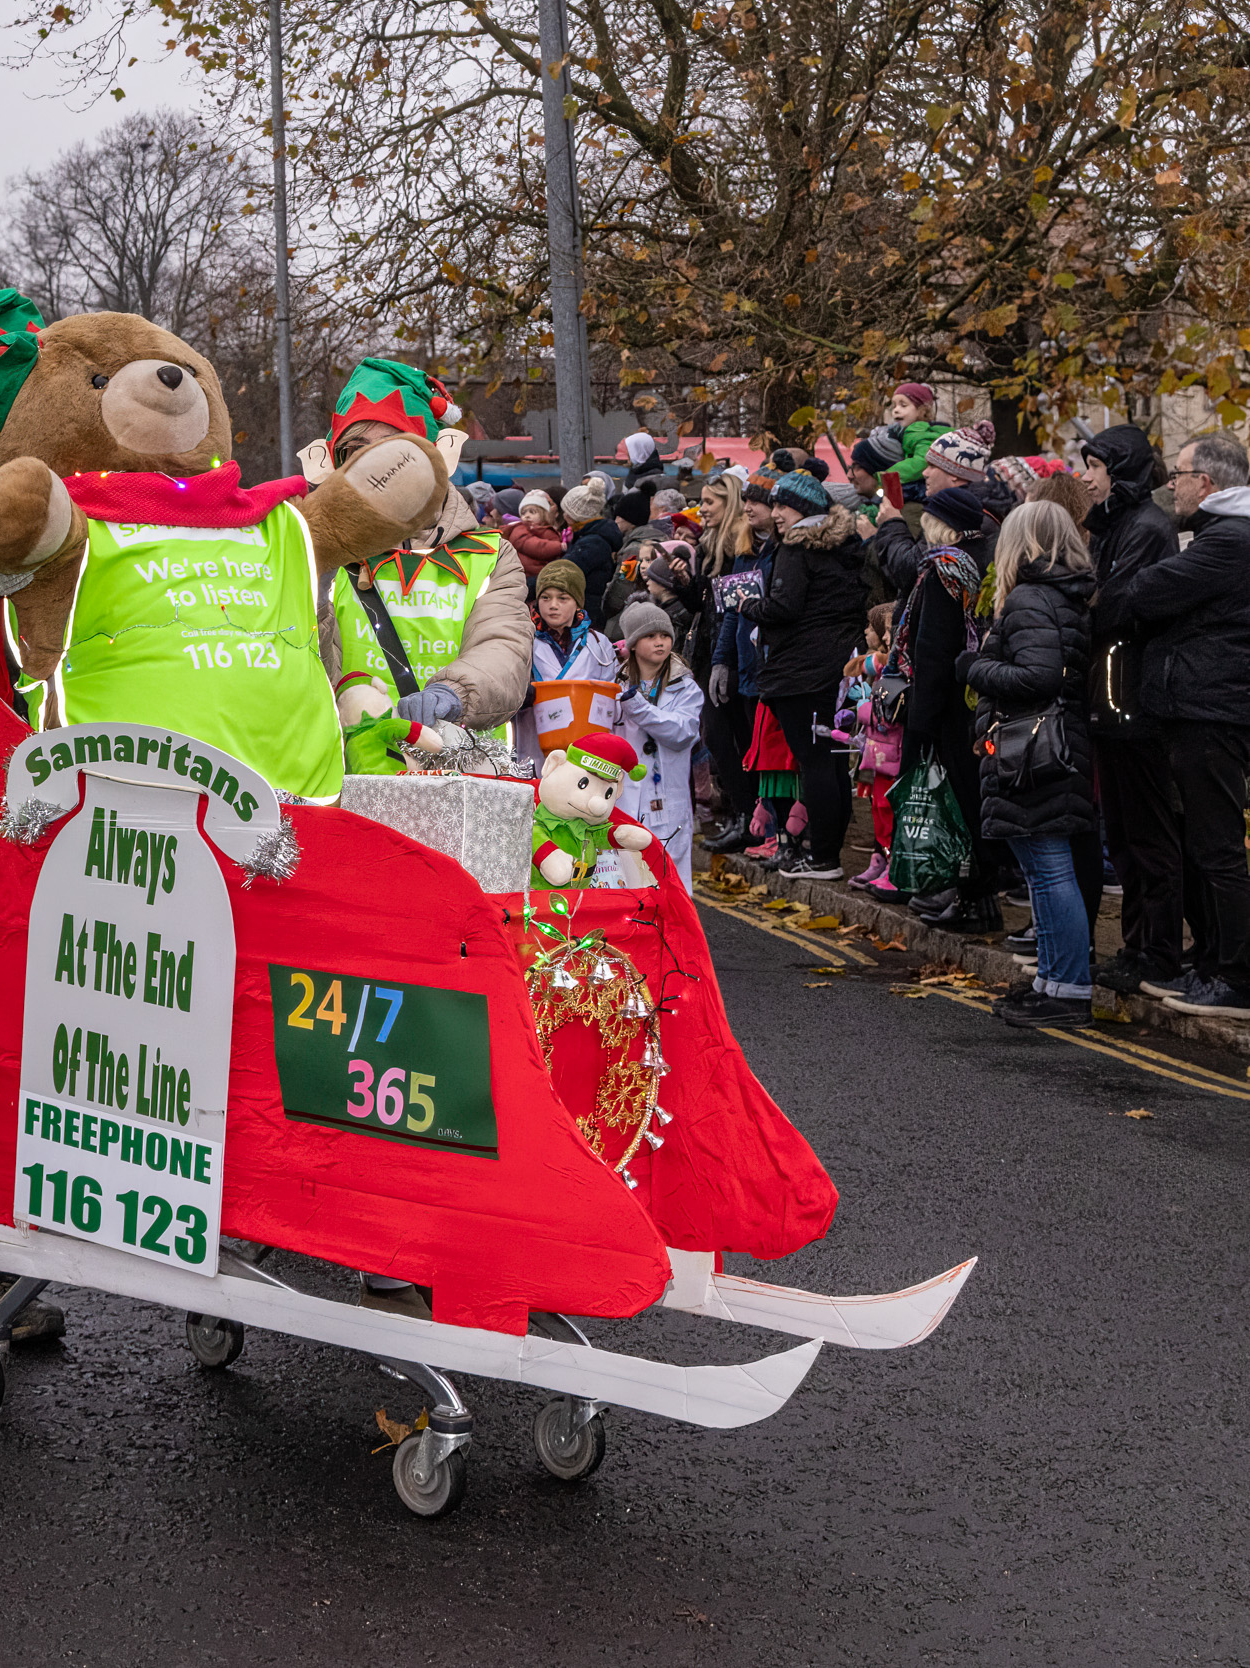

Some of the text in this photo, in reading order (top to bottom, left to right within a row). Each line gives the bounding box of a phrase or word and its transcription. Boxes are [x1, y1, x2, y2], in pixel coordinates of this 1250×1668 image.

[134, 556, 273, 584] We're here
[165, 583, 268, 607] to listen
[183, 642, 282, 670] 116 123
[418, 634, 459, 654] her
[25, 733, 259, 822] Samaritans
[54, 913, 195, 1013] At The End
[287, 972, 404, 1053] 24/7
[52, 1022, 191, 1127] Of The Line
[346, 1059, 436, 1133] 365
[24, 1097, 213, 1185] FREEPHONE
[22, 1162, 208, 1265] 116 123
